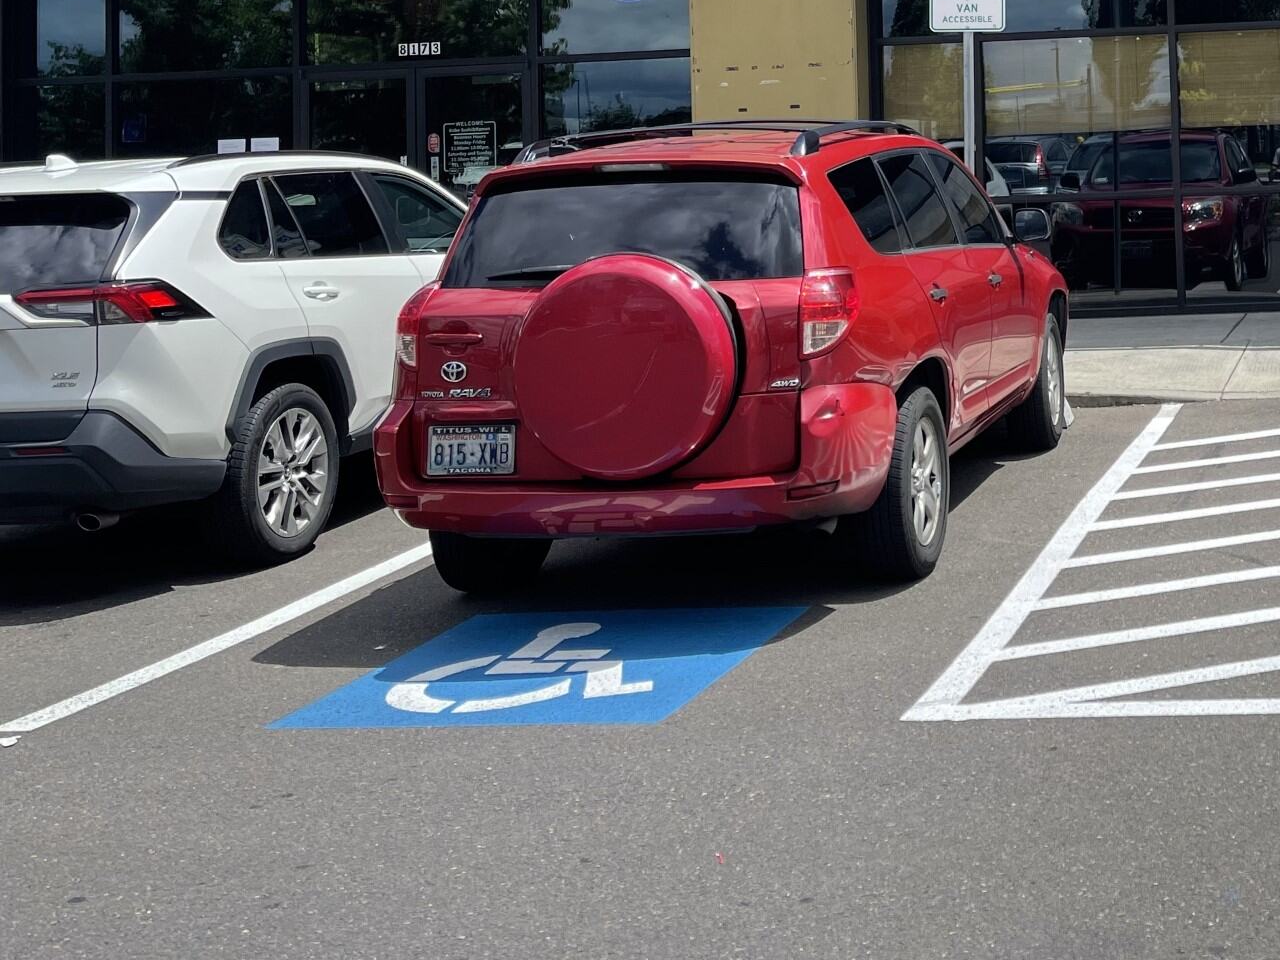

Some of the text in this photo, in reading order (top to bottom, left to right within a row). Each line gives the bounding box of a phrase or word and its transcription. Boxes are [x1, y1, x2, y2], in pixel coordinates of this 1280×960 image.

[956, 3, 978, 13] VAN
[942, 15, 993, 23] ACCESSIBLE
[399, 42, 440, 56] 8173
[770, 378, 799, 387] 4WD
[448, 387, 492, 398] RAV4
[434, 426, 509, 434] TITUS-WIL
